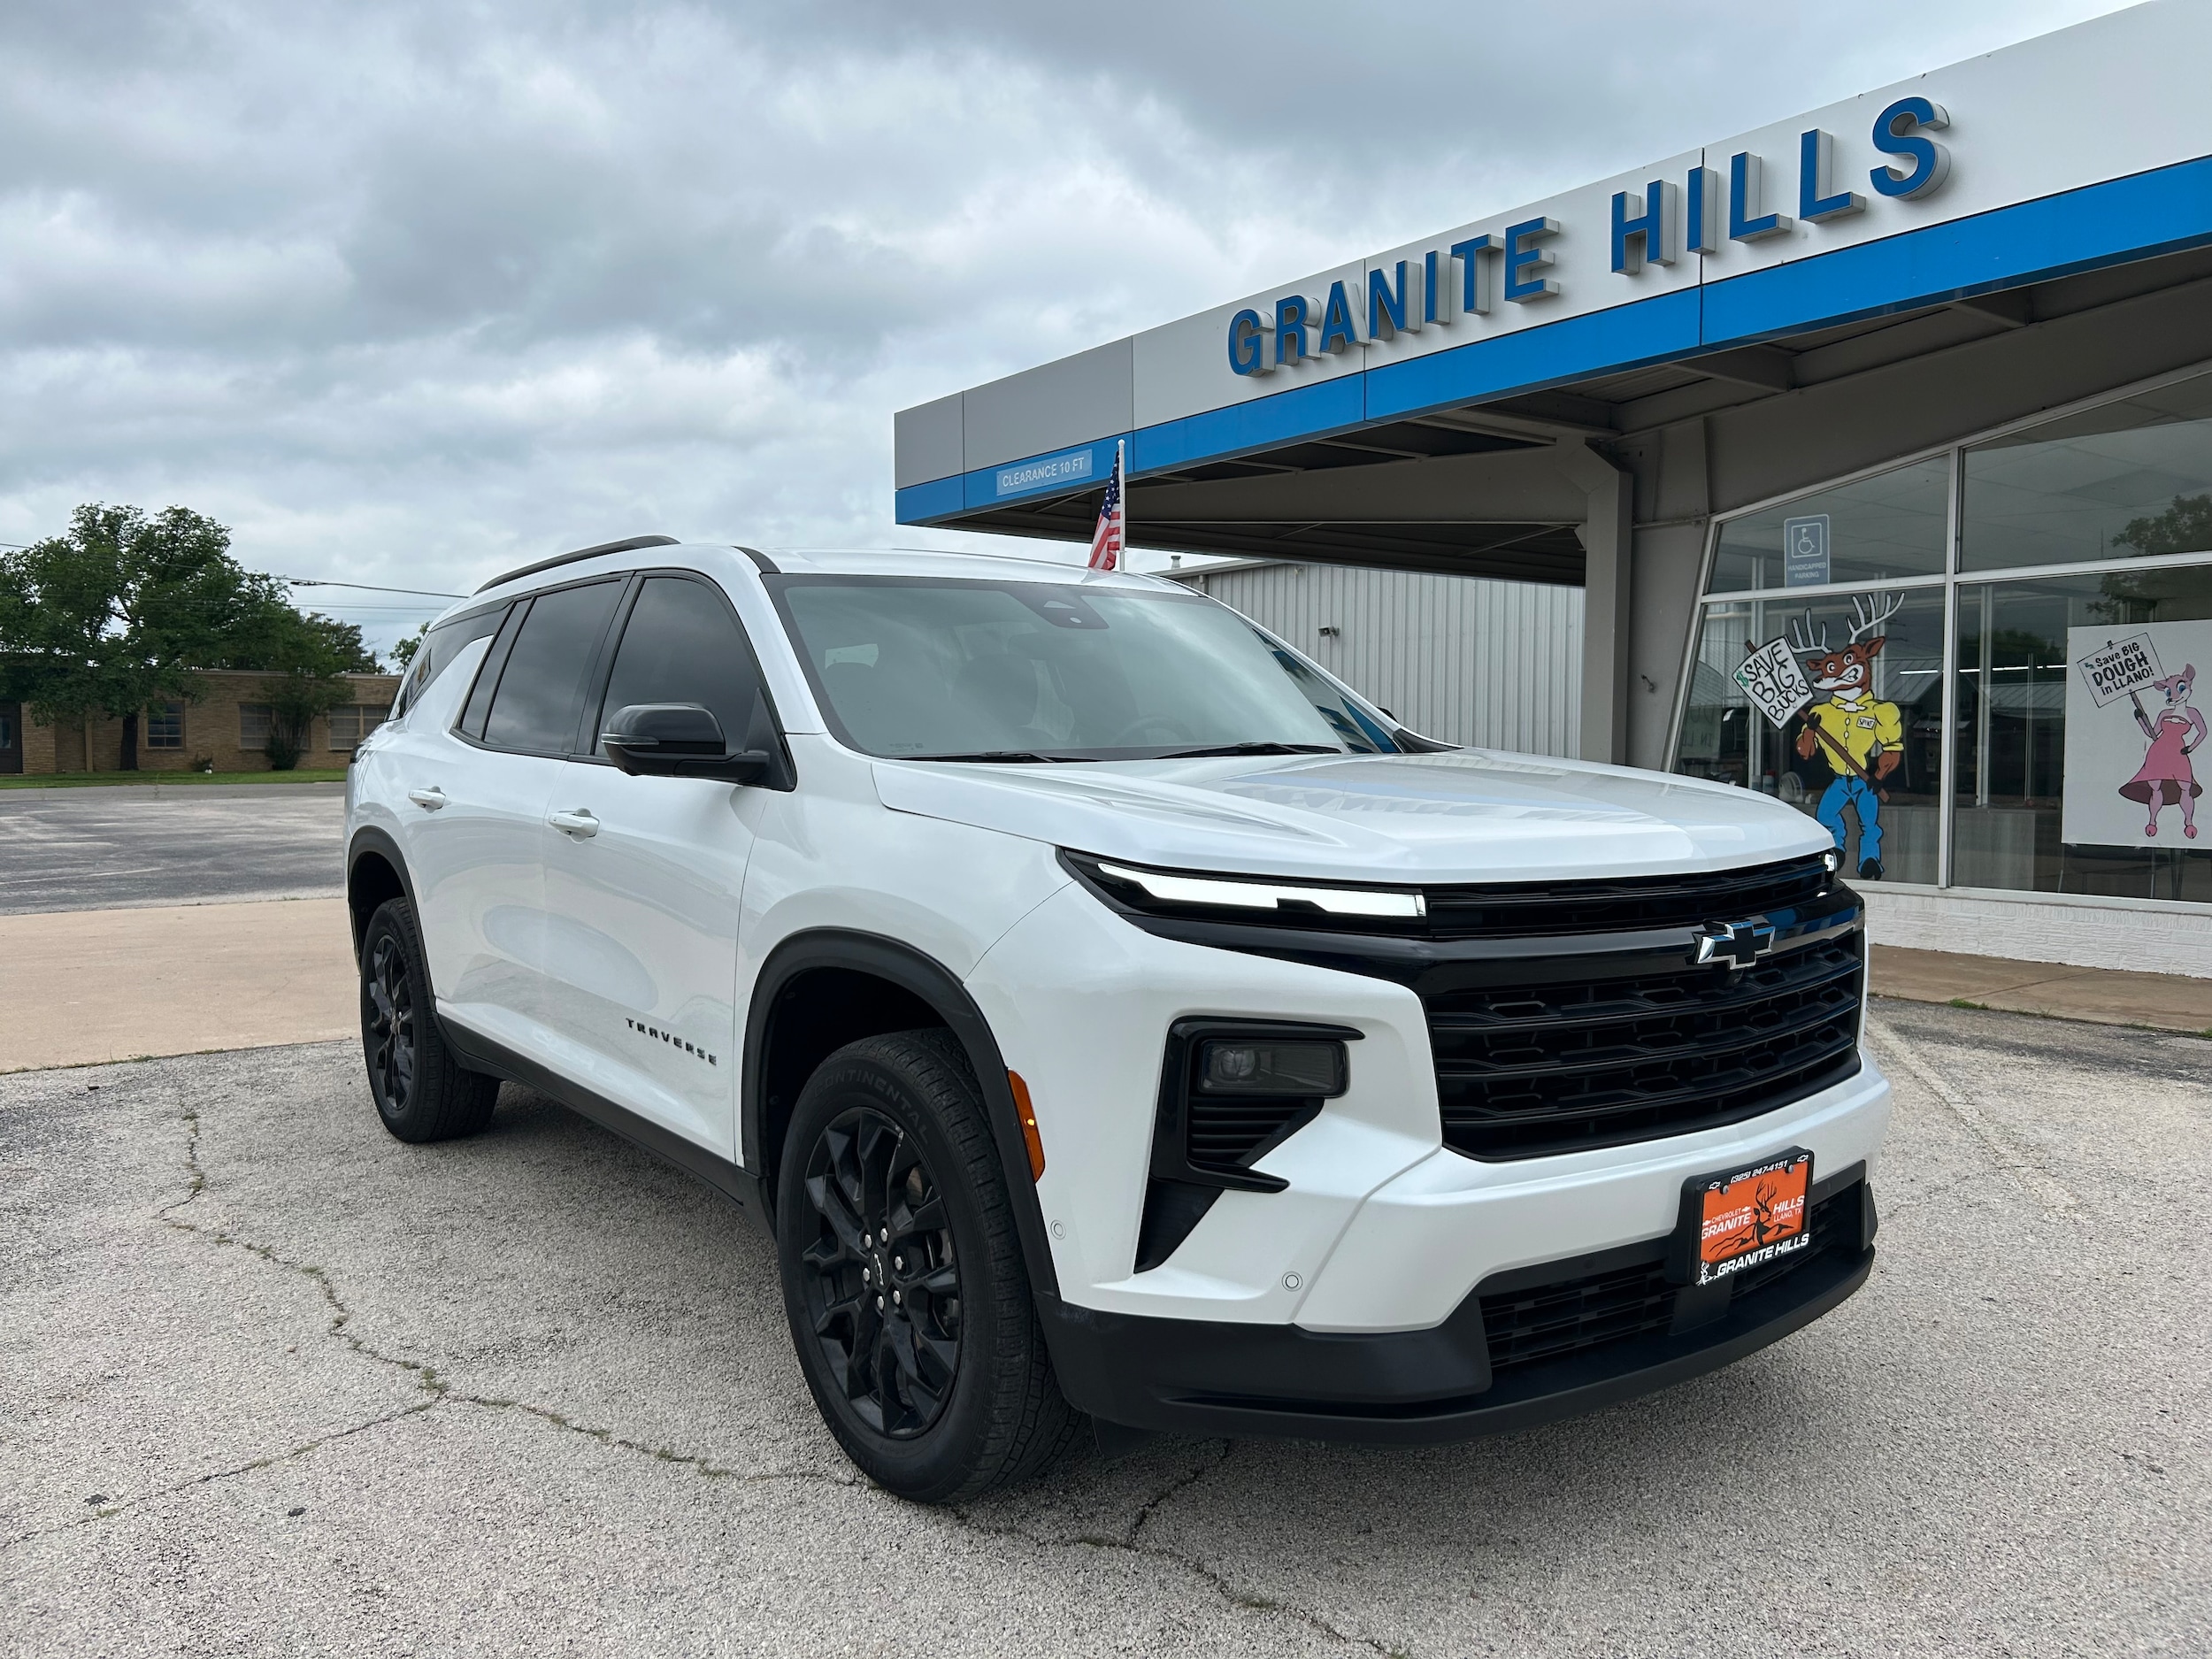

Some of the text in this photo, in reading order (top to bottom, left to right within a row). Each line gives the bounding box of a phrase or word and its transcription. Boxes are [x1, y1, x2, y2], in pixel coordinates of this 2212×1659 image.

[1227, 96, 1951, 378] GRANITE HILLS
[1002, 457, 1085, 488] CLEARANCE 10 FT
[1787, 562, 1827, 572] HANDICAPPED
[1794, 571, 1820, 580] PARKING
[1744, 642, 1788, 682] SAVE
[2092, 651, 2149, 687] DOUGH
[2095, 641, 2139, 667] Save BIG
[1752, 664, 1795, 704] BIG
[2100, 666, 2154, 695] in LLANO!
[1768, 680, 1809, 721] BUCKS
[626, 1018, 717, 1066] TRAVERSE
[814, 1068, 931, 1145] CONTINENTAL
[1731, 1160, 1788, 1184] (325) 247-4151
[1701, 1194, 1805, 1240] GRANITE HILLS
[1711, 1208, 1741, 1223] CHEVROLET
[1793, 1208, 1802, 1217] TX
[1717, 1233, 1809, 1276] GRANITE HILLS
